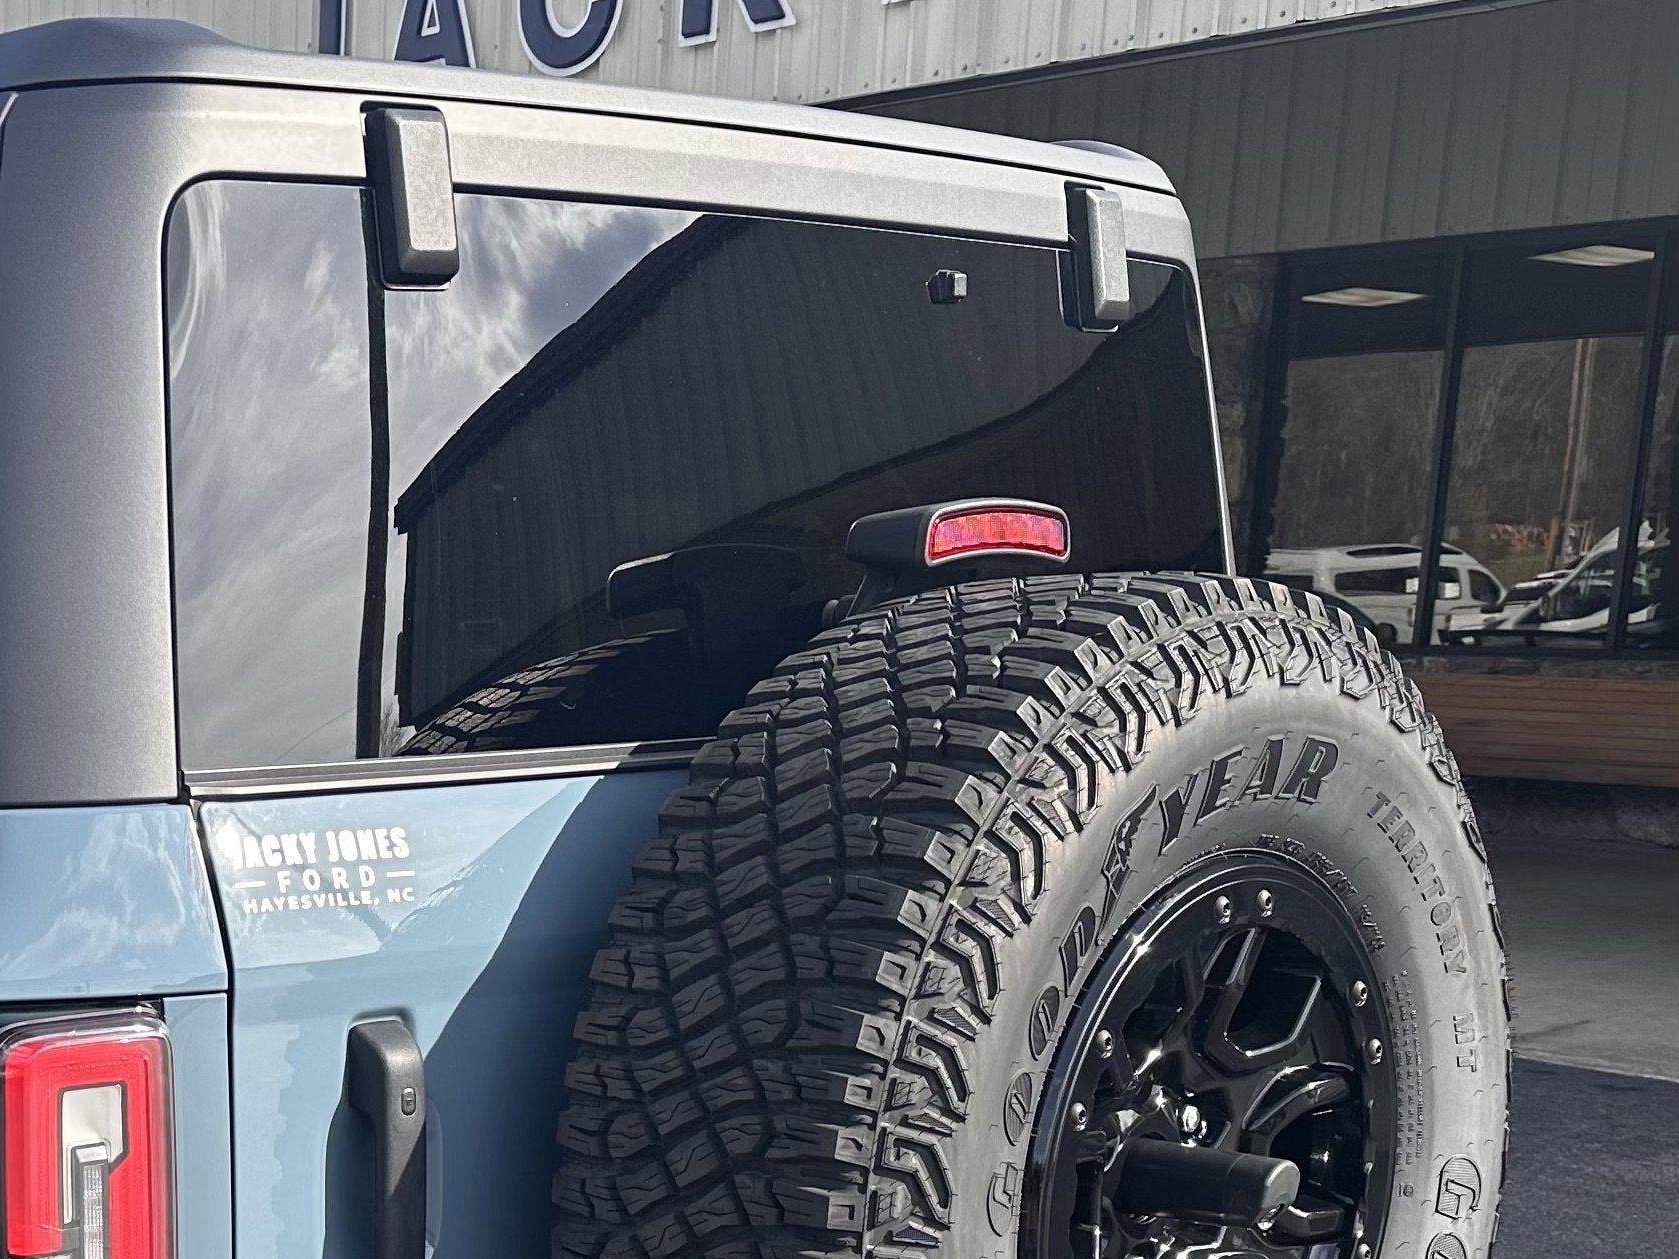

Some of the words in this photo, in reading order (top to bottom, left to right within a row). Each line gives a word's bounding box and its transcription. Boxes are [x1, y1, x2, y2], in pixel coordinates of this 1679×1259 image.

[326, 826, 410, 863] JONES
[277, 864, 376, 894] FORD
[1367, 791, 1467, 974] TERRITORY
[243, 890, 380, 915] HAYESVILLE,
[387, 886, 415, 903] NC
[987, 735, 1339, 1238] GOODYEAR
